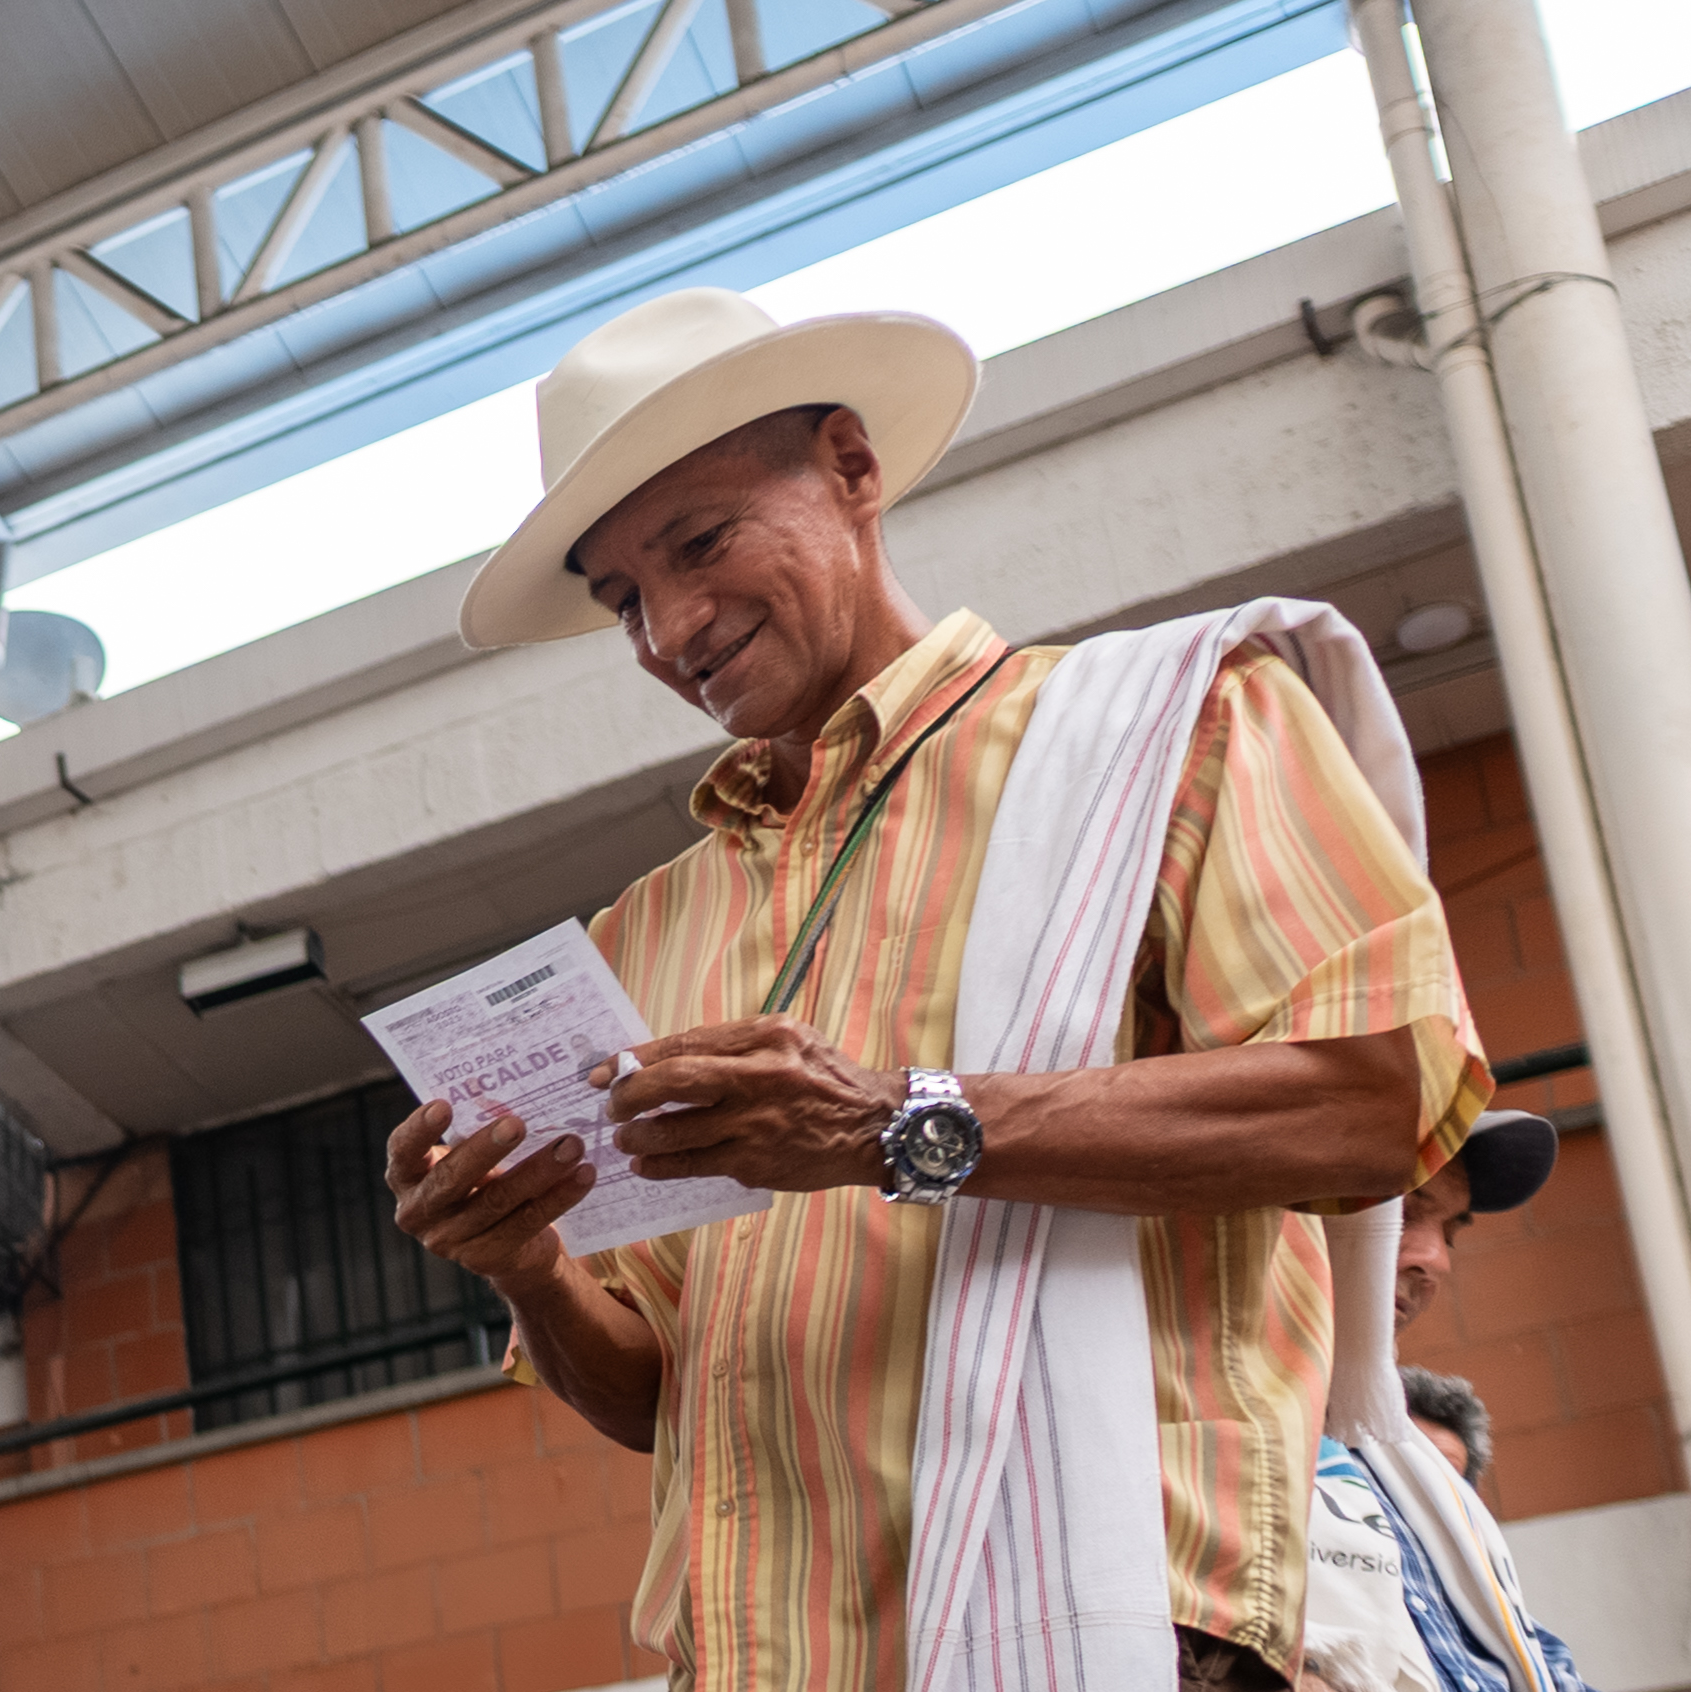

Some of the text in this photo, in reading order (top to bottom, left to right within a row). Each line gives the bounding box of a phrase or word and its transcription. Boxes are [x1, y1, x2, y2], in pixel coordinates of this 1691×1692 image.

[434, 1045, 518, 1085] VOTO PARA
[448, 1042, 569, 1105] ALCALDE
